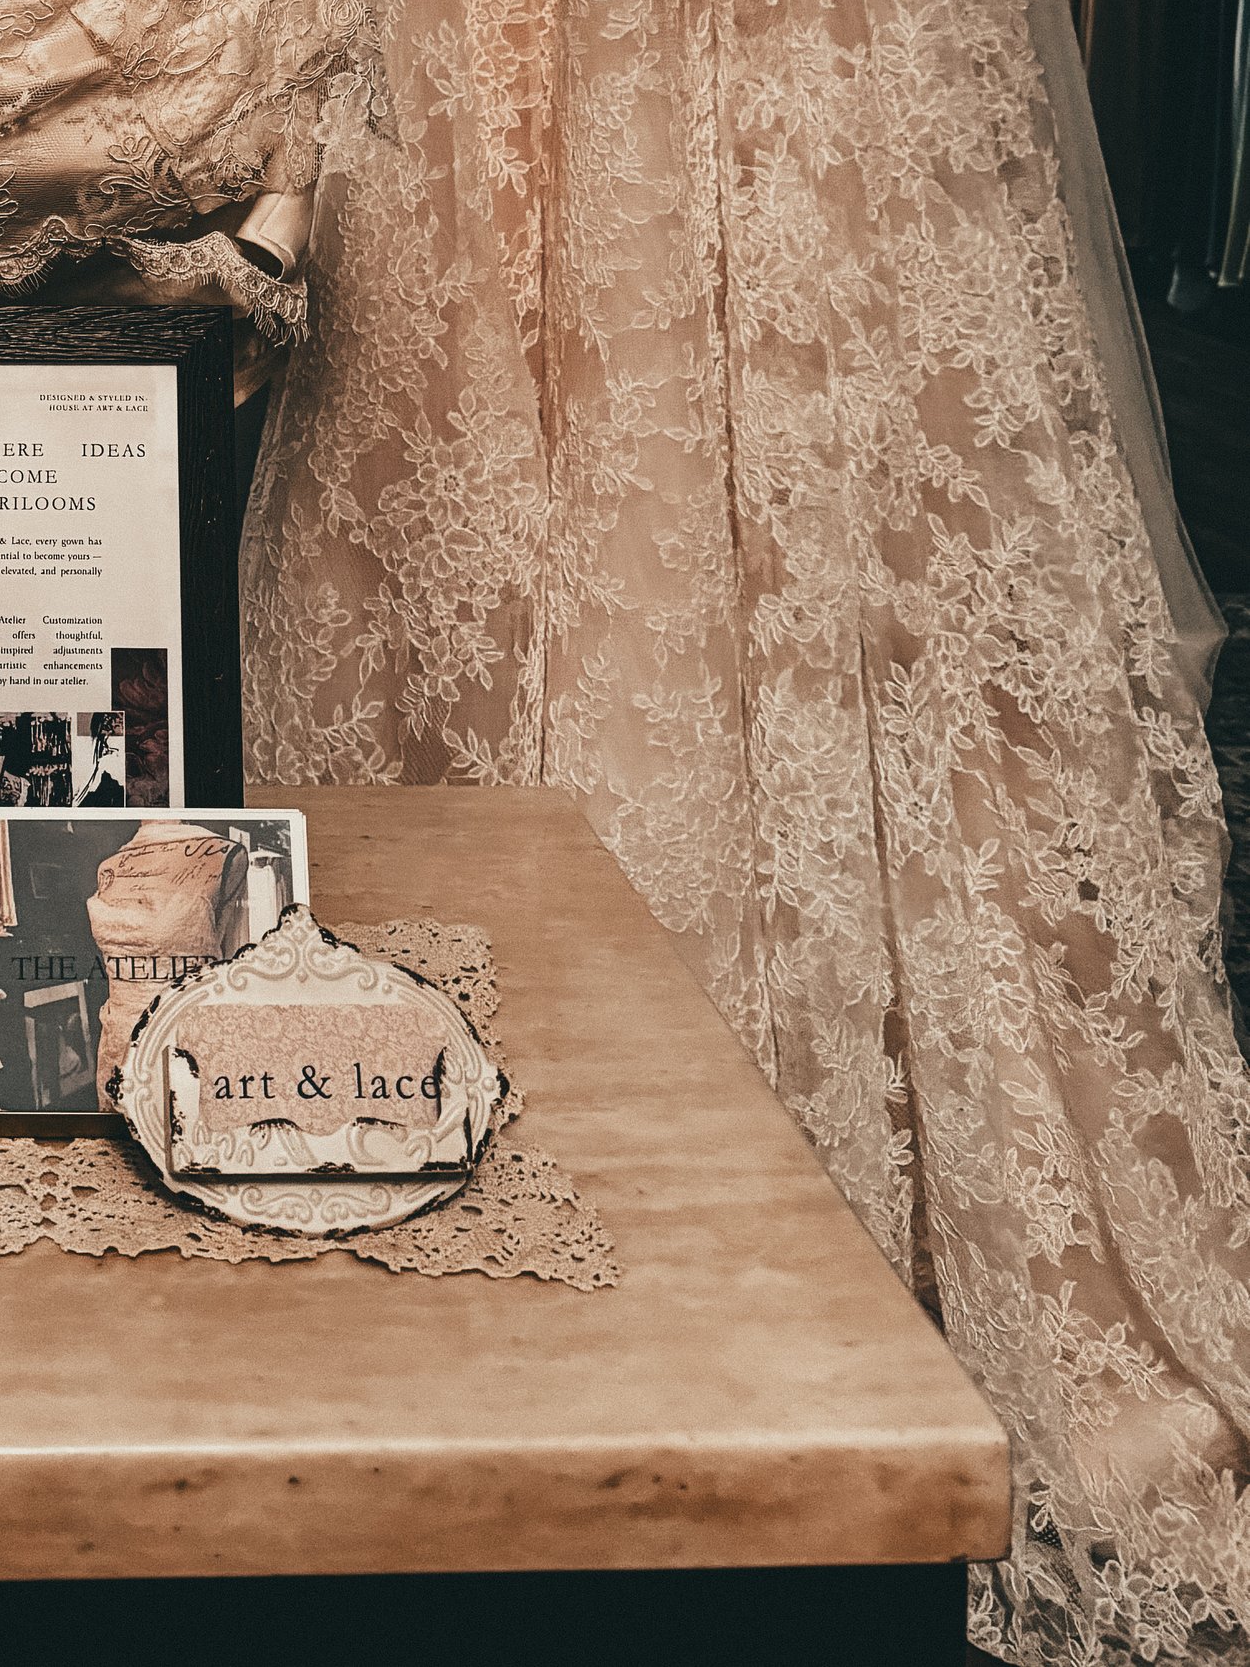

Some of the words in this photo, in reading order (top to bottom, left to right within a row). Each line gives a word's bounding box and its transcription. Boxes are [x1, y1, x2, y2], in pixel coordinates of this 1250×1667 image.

[39, 393, 86, 402] DESIGNED
[97, 394, 132, 402] STYLED
[49, 404, 80, 412] HOUSE
[81, 404, 94, 412] AT
[96, 404, 114, 412] ART
[125, 404, 149, 412] LACE
[81, 443, 146, 458] IDEAS
[11, 536, 32, 546] Lace,
[35, 538, 58, 548] every
[61, 538, 85, 548] gown
[87, 536, 103, 546] has
[22, 552, 32, 561] to
[33, 550, 66, 561] become
[67, 553, 91, 563] yours
[0, 565, 37, 576] elevated,
[40, 565, 57, 576] and
[60, 566, 103, 578] personally
[42, 615, 103, 625] Customization
[11, 629, 36, 640] offers
[55, 630, 103, 643] thoughtful,
[52, 645, 104, 657] adjustments
[42, 660, 103, 671] enhancements
[9, 675, 31, 686] hand
[32, 676, 42, 686] in
[43, 678, 59, 686] our
[60, 676, 89, 686] atelier.
[11, 955, 78, 980] THE
[213, 1071, 276, 1100] art
[296, 1064, 333, 1100] &
[352, 1062, 440, 1100] lace
